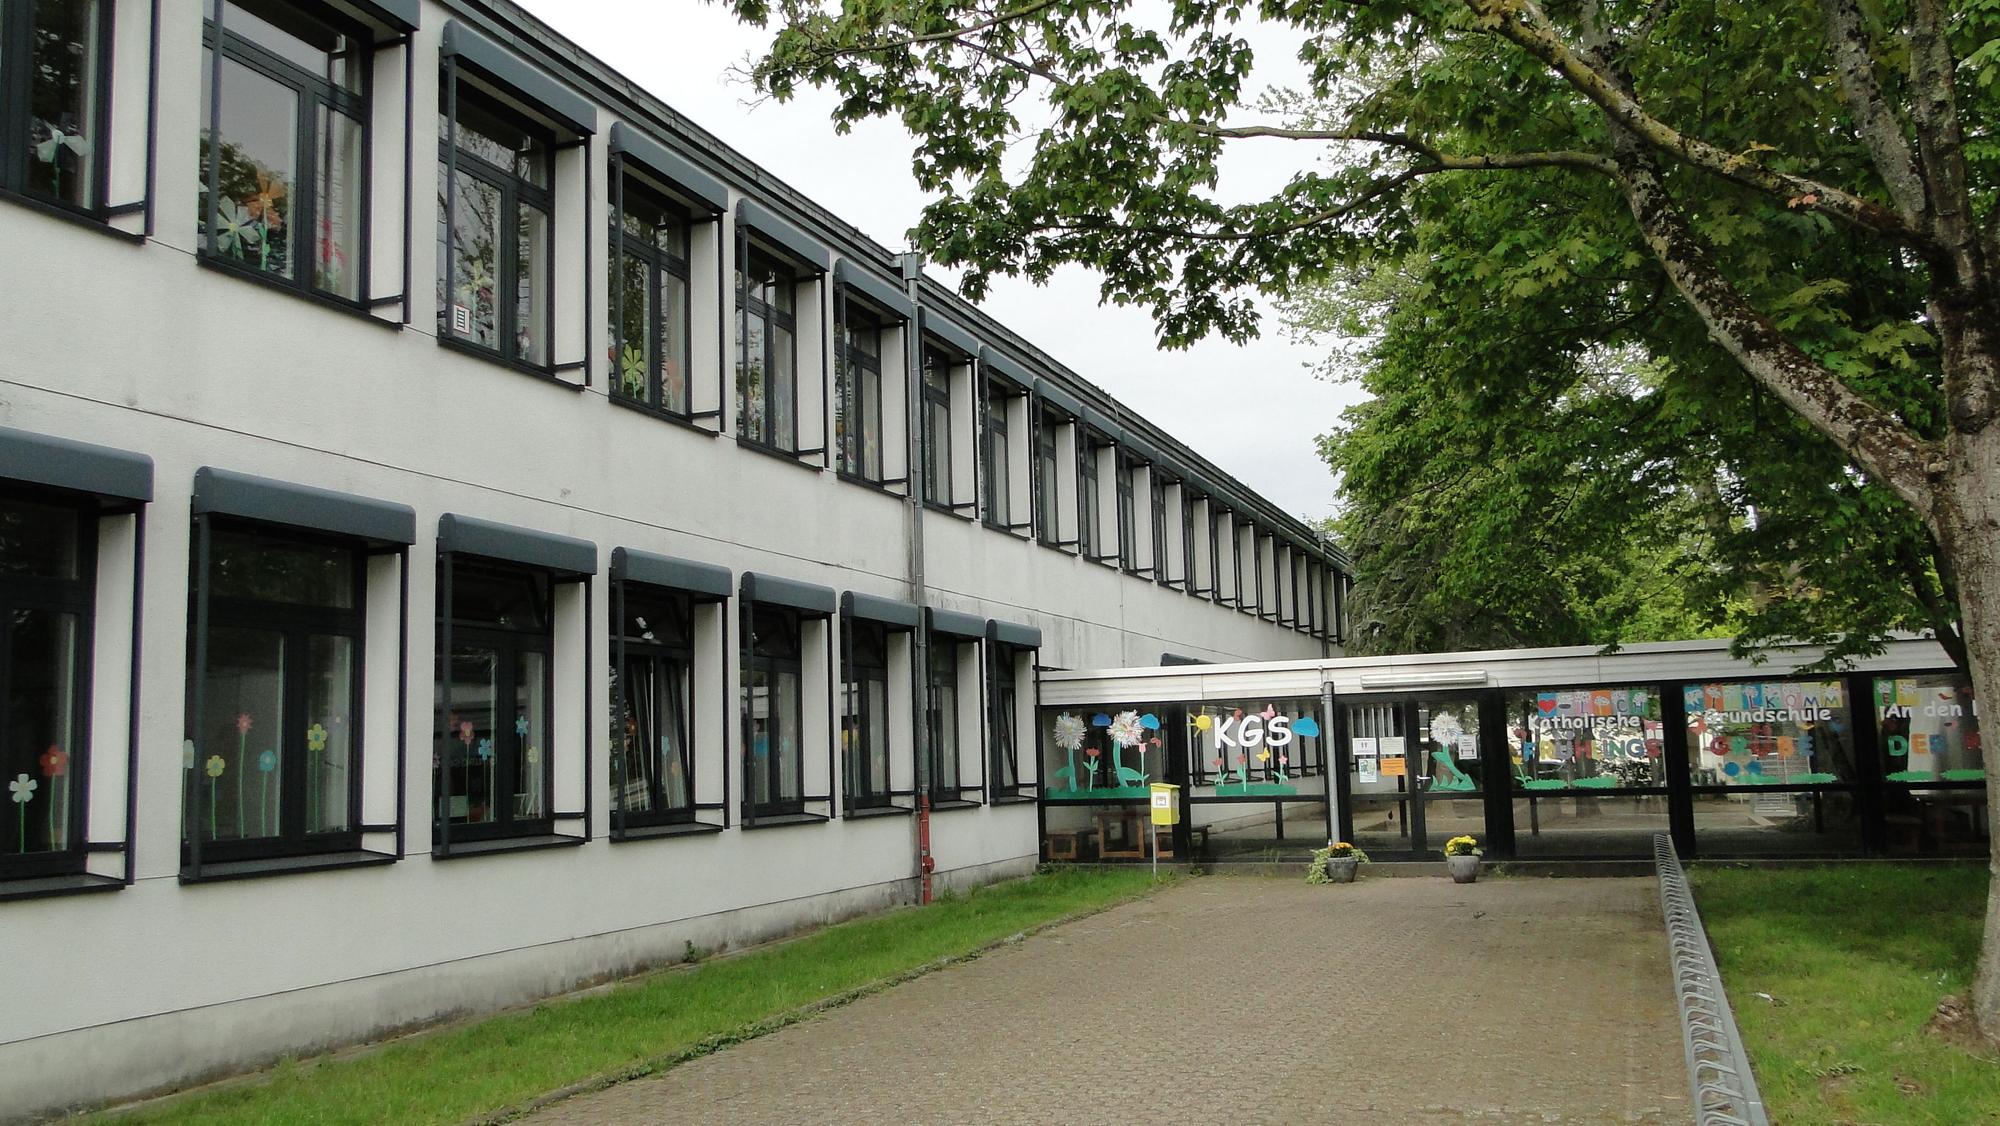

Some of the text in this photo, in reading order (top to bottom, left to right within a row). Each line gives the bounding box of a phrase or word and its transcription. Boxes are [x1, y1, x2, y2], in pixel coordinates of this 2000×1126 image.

[1528, 713, 1641, 729] Katholische
[1704, 704, 1832, 723] Grundschule
[1924, 700, 1962, 717] den
[1214, 715, 1292, 748] KGS
